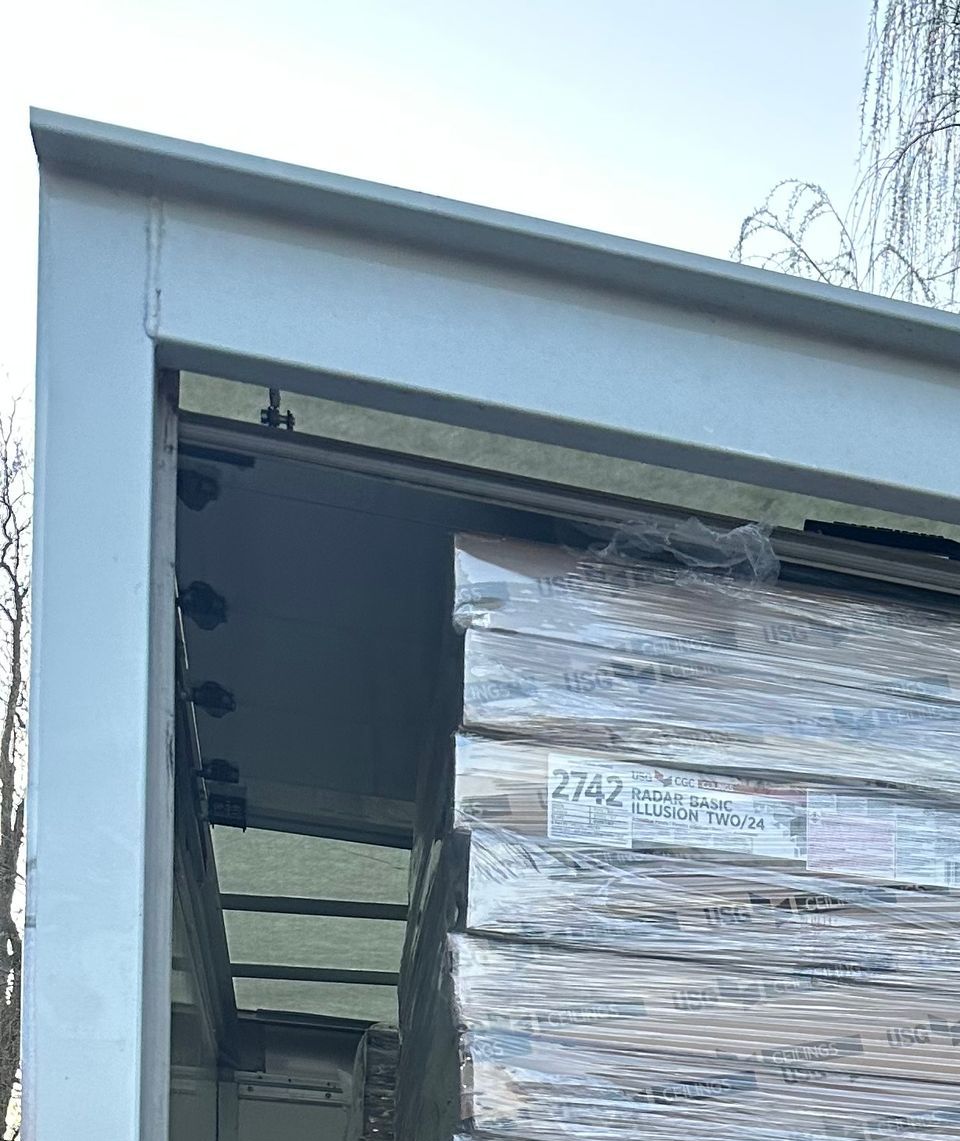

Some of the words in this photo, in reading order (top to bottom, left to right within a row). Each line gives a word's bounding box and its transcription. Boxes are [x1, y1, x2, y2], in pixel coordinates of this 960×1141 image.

[552, 769, 623, 807] 2742
[674, 776, 695, 787] CGC
[631, 787, 684, 807] RADAR
[690, 795, 733, 812] BASIC
[631, 802, 699, 822] ILLUSION
[706, 811, 765, 831] TWO/24
[886, 1024, 929, 1048] USG
[772, 1042, 838, 1064] CEILINGS
